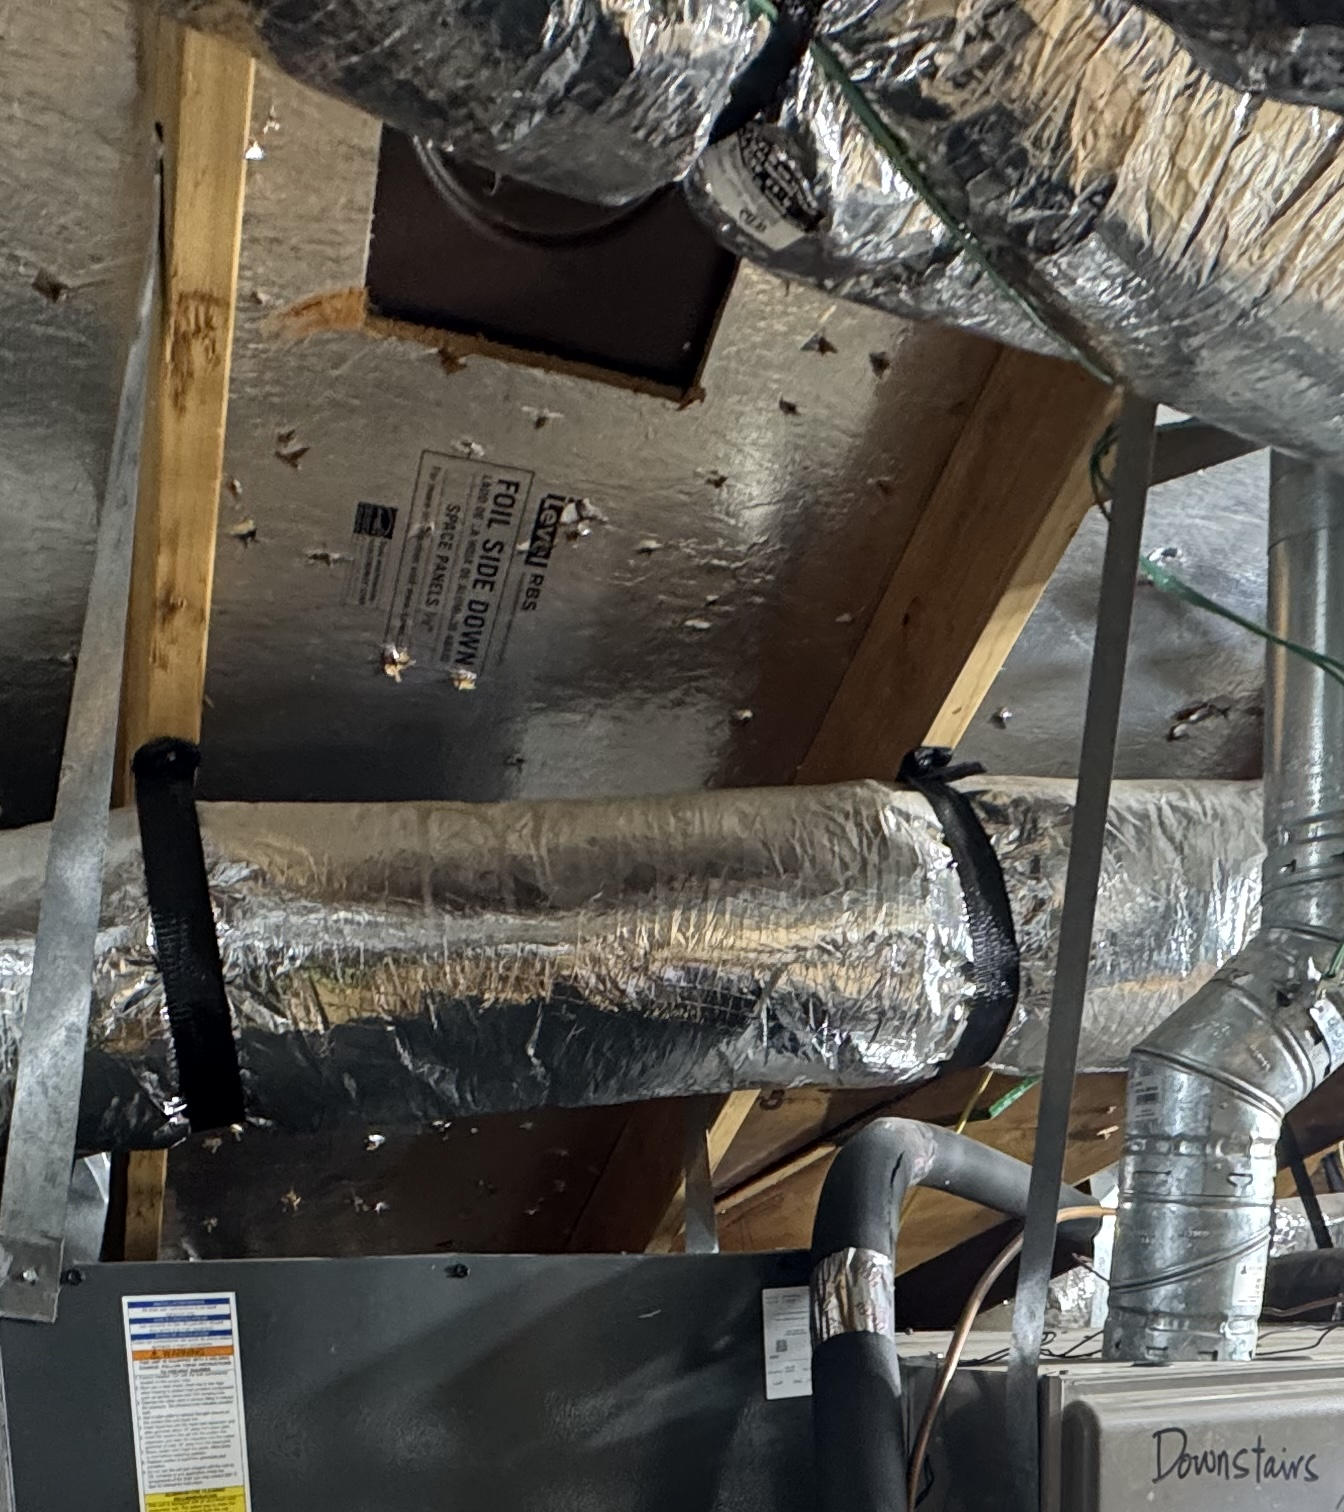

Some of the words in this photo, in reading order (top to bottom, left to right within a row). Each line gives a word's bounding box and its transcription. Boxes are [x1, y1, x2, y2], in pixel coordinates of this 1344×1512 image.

[437, 503, 461, 555] SPACE
[486, 478, 520, 530] FOIL
[424, 555, 450, 608] PANELS
[471, 540, 505, 594] SIDE
[521, 572, 545, 612] RBS
[454, 600, 489, 668] DOWN
[1151, 1427, 1320, 1485] Downstairs
